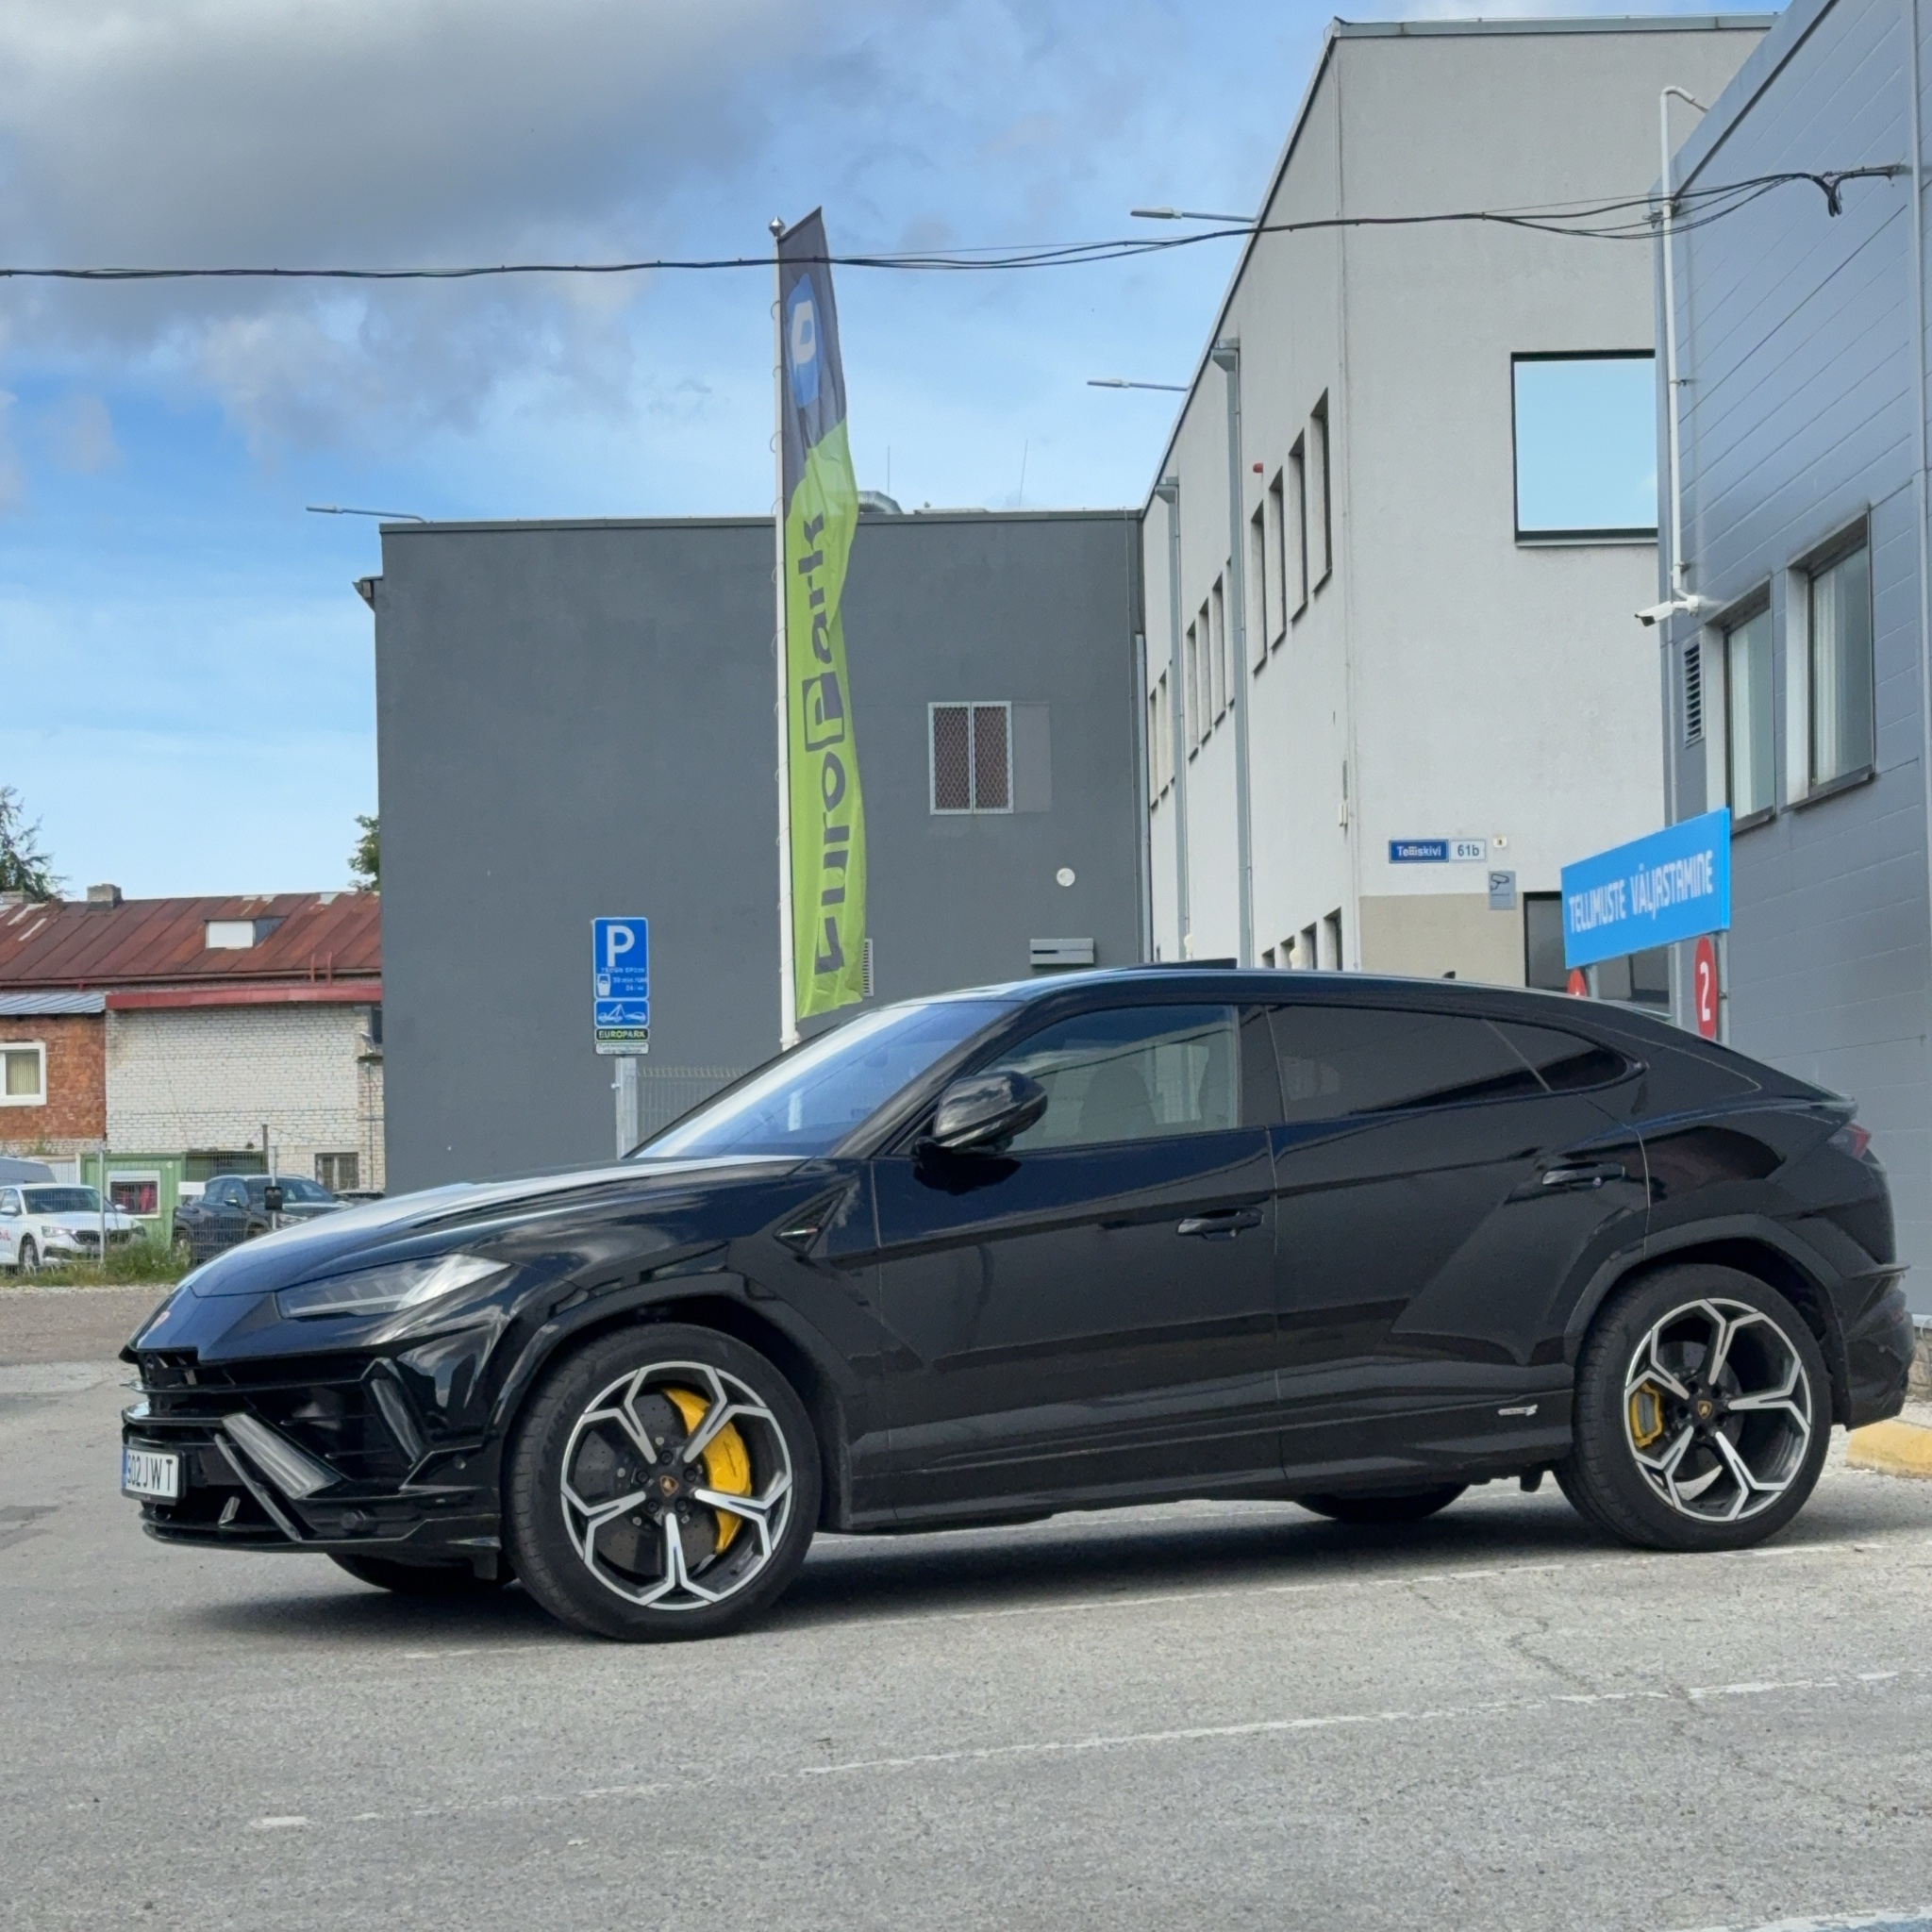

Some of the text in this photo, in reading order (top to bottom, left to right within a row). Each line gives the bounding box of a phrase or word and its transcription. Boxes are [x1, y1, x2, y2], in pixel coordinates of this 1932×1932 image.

[1396, 844, 1442, 858] Telliskivi
[1457, 843, 1480, 857] 61b
[1568, 879, 1627, 934] TELLIMUSTE
[607, 924, 635, 967] P
[1699, 960, 1711, 1023] 2
[598, 1030, 646, 1039] EUROPARK
